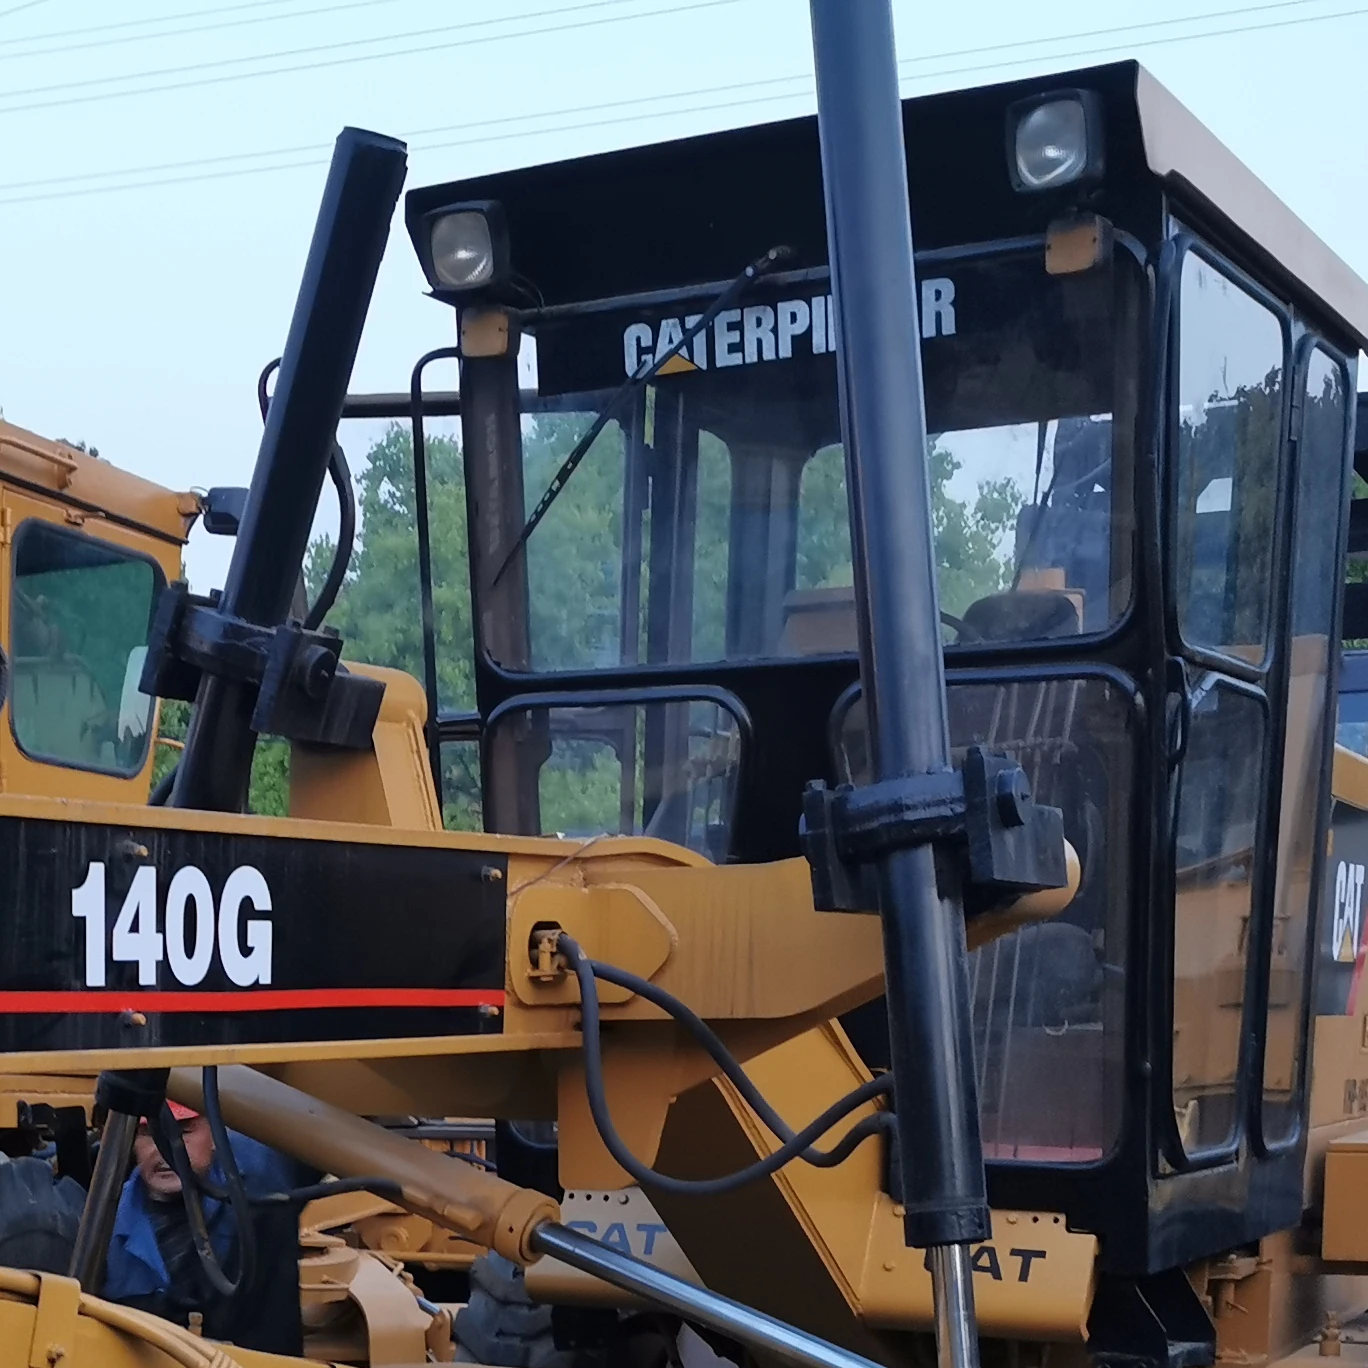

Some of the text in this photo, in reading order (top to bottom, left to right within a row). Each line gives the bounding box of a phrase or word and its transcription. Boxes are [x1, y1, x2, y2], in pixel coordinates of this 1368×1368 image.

[623, 277, 957, 379] CATERPIR
[72, 861, 273, 988] 140G
[1332, 860, 1365, 962] CAT
[924, 1245, 1047, 1283] AT
